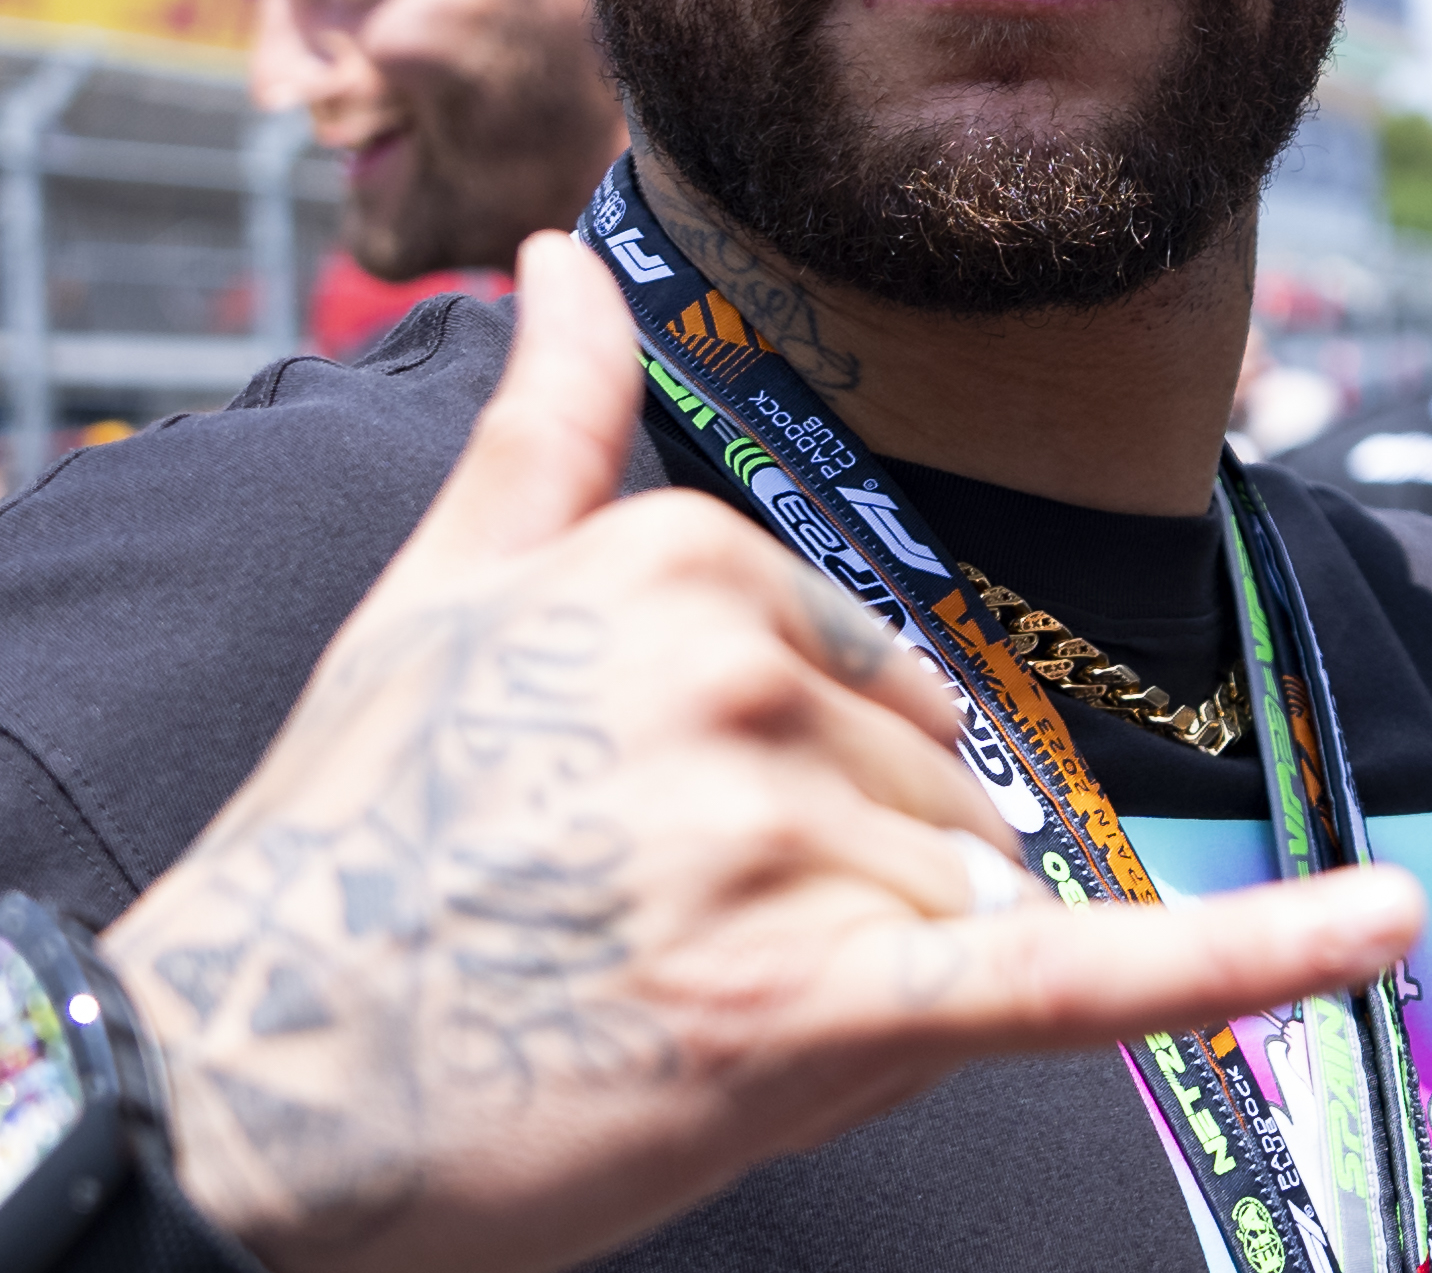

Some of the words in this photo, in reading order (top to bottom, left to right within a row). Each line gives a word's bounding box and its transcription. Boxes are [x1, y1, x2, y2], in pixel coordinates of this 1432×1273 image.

[748, 389, 842, 480] PADDOCK
[802, 416, 857, 469] CLUB
[1035, 717, 1090, 795] 2023
[1093, 808, 1156, 906] SPAIN
[1144, 1031, 1186, 1086] ZE
[1315, 995, 1367, 1199] SPAIN
[1168, 1081, 1237, 1176] NET
[1226, 1064, 1292, 1192] PADDOCK
